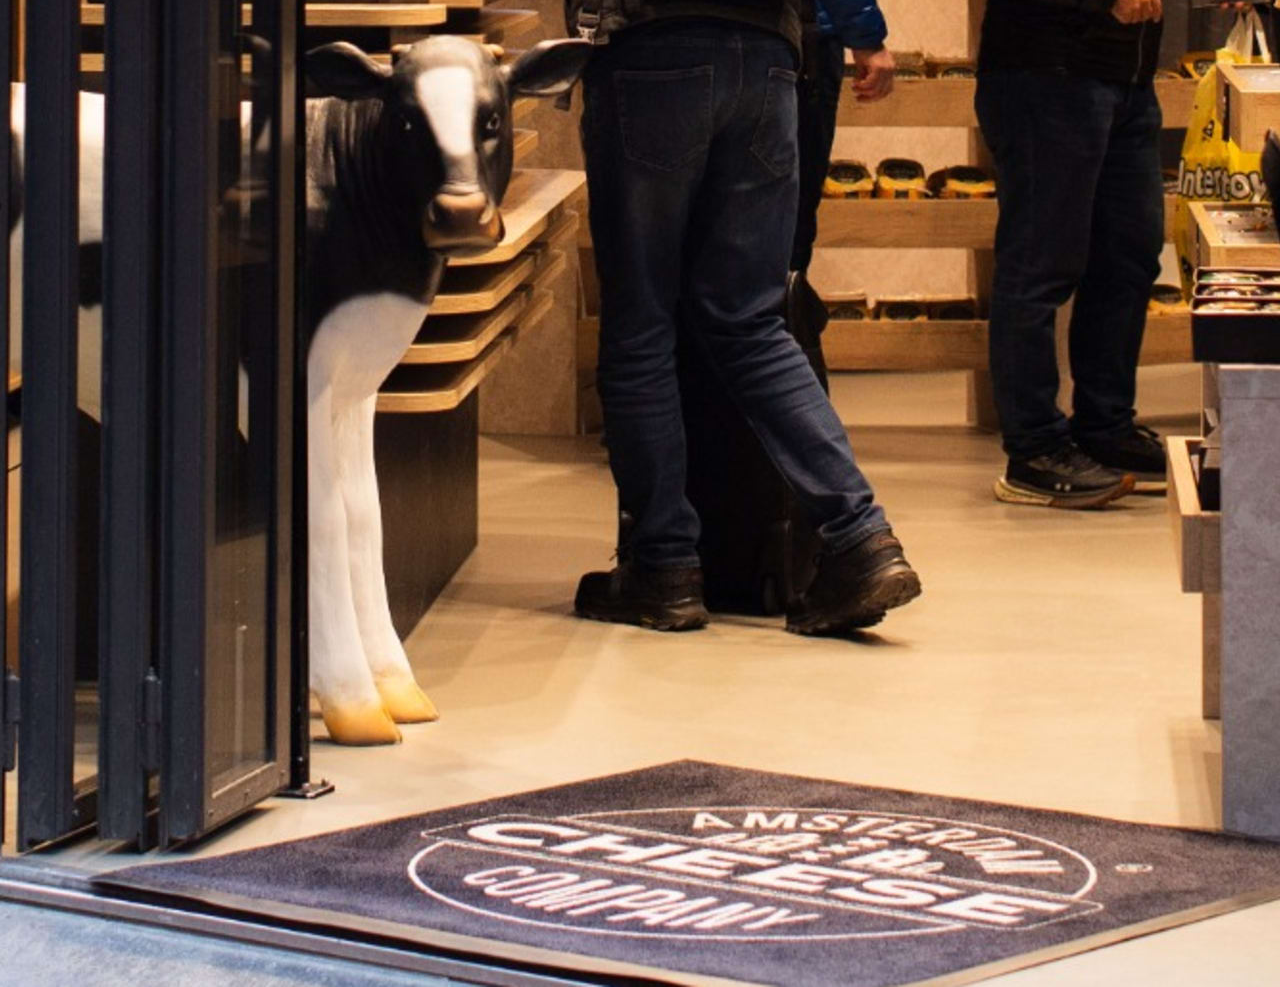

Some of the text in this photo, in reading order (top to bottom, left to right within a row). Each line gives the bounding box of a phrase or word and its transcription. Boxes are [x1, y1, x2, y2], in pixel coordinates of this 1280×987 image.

[1177, 157, 1268, 203] Intertoy
[467, 822, 1073, 925] CHEESE
[692, 810, 1065, 875] AMSTERDAM
[463, 864, 821, 931] COMPANY
